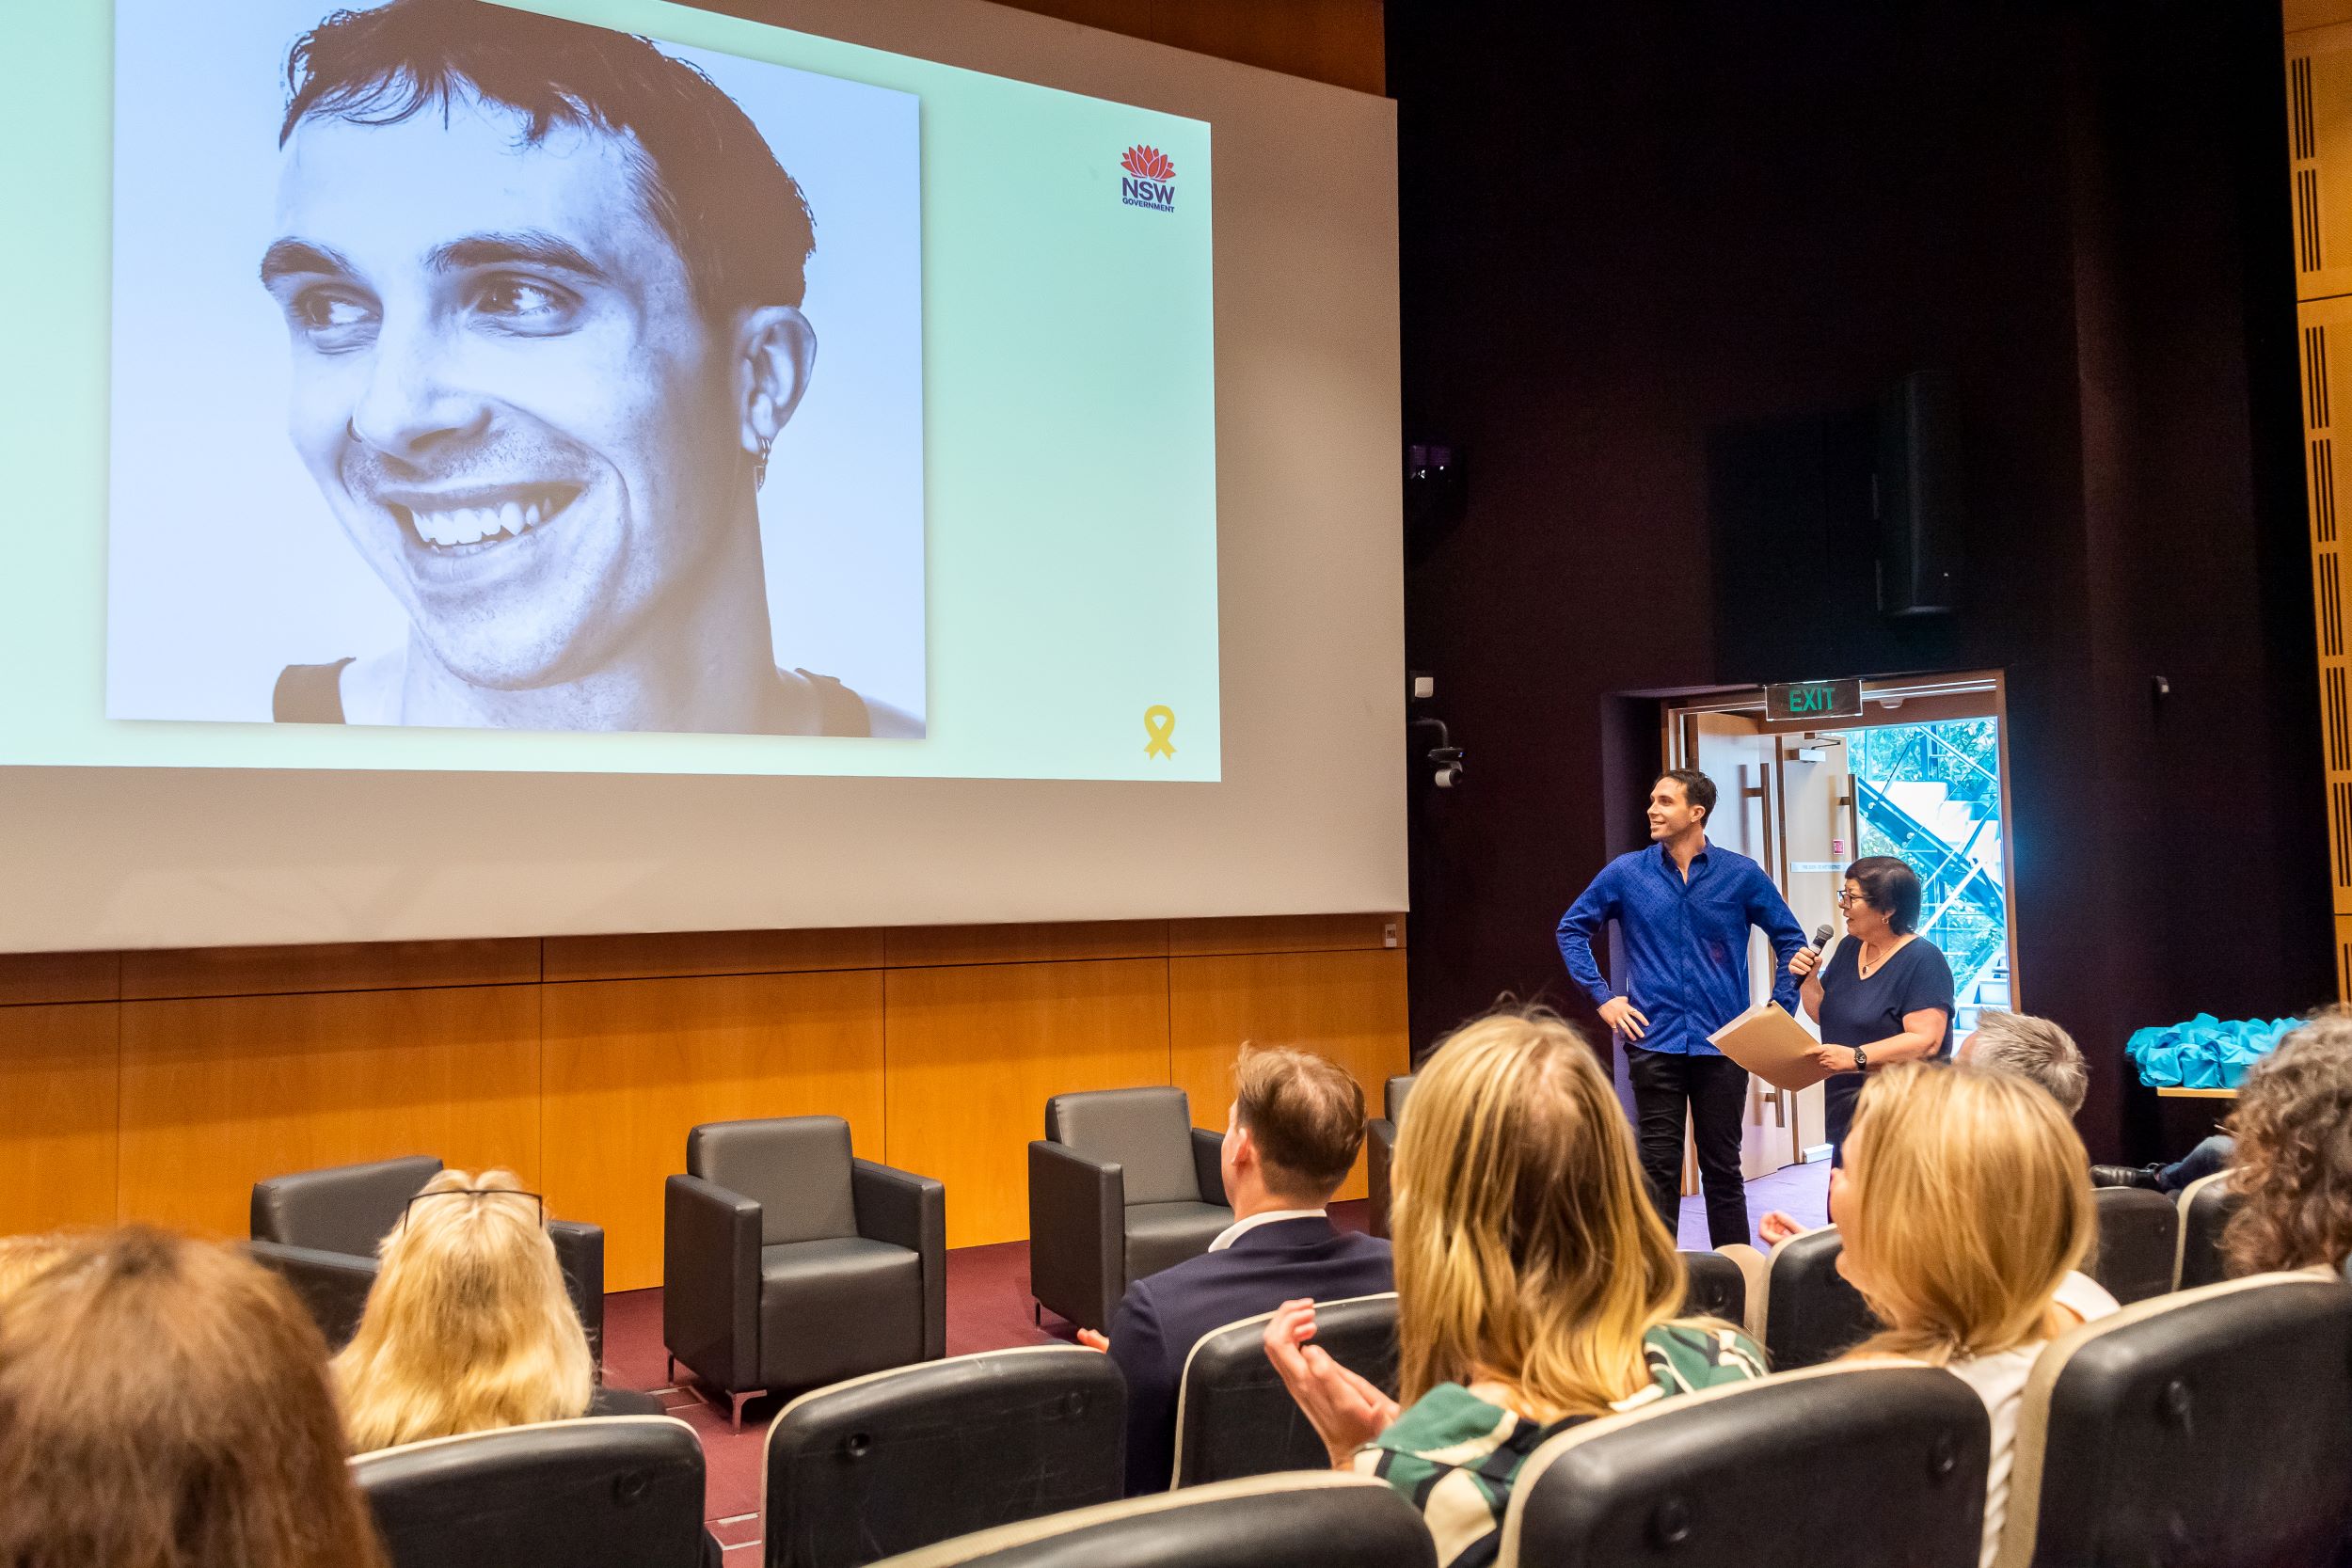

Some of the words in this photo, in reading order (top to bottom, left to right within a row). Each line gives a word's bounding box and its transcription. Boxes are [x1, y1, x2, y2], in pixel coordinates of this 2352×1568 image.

[1122, 177, 1175, 205] NSW
[1122, 198, 1175, 213] GOVERNMENT
[1789, 688, 1836, 711] EXIT
